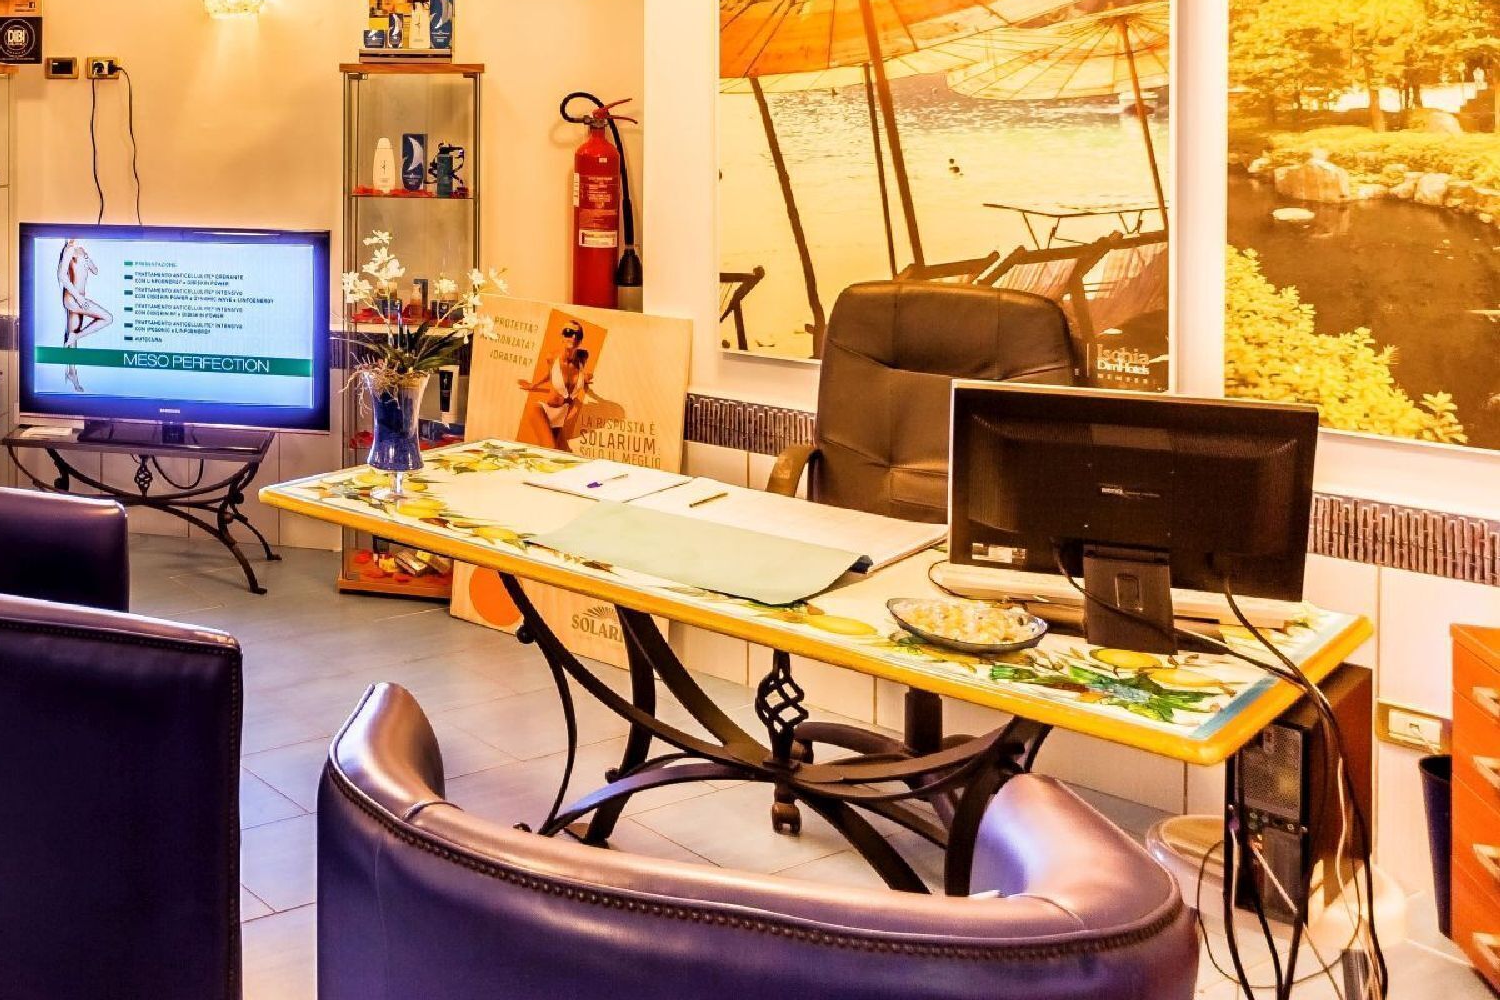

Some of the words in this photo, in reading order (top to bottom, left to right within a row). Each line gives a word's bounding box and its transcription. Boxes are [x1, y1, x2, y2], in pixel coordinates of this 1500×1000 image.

[123, 352, 169, 368] MESO
[172, 356, 270, 373] PERFECTION
[1096, 343, 1150, 365] Ischia
[580, 414, 593, 429] LA
[596, 416, 645, 435] RISPOSTA
[579, 428, 656, 455] SOLARIUM
[579, 446, 605, 459] SOLO
[621, 452, 661, 470] MEGLIO
[571, 613, 624, 643] SOLARI
